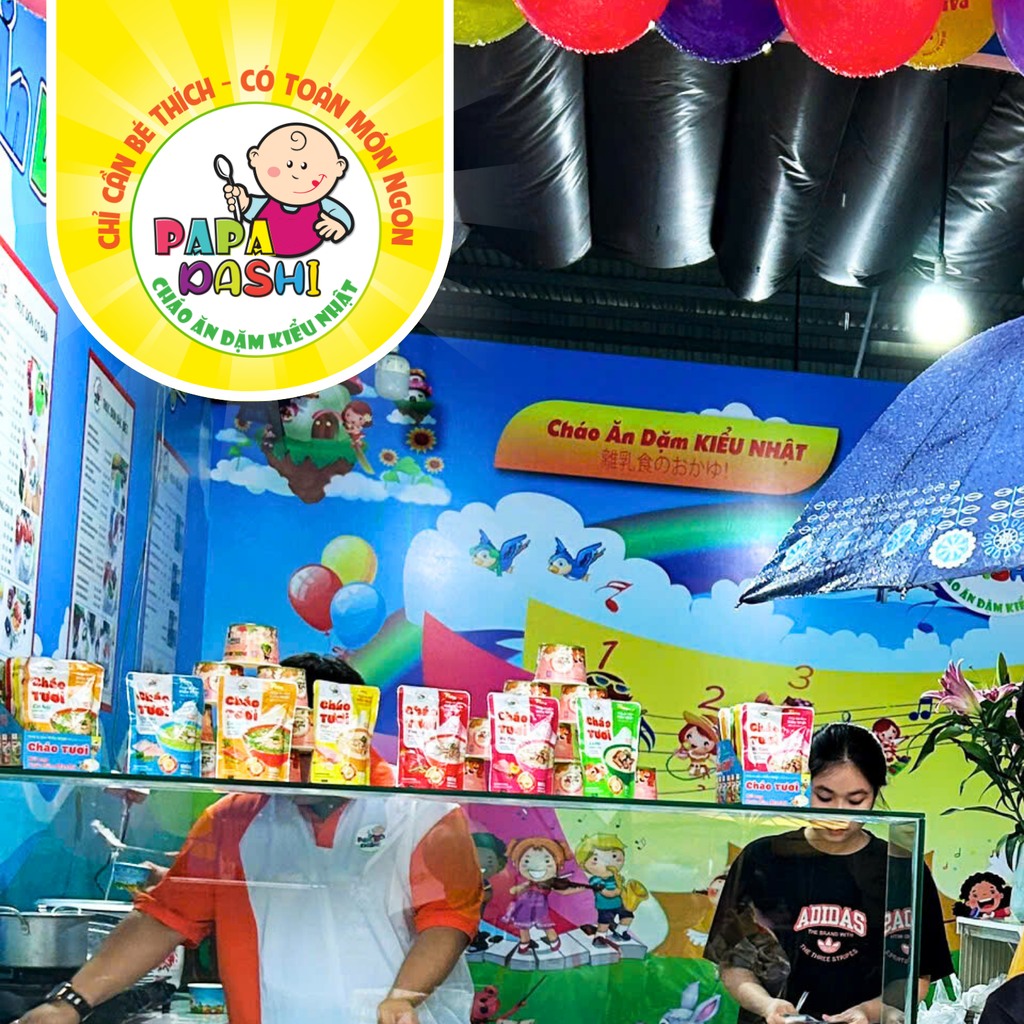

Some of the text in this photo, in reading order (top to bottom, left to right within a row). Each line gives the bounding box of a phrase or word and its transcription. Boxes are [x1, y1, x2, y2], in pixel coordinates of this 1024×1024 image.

[547, 418, 809, 466] Cháo Ăn Dặm KIỂU NHẬT
[601, 640, 619, 670] 1
[788, 665, 815, 690] 3
[698, 685, 725, 710] 2
[28, 742, 89, 755] Cháo Tươi
[746, 782, 799, 791] Cháo Tươi
[793, 903, 867, 937] ADIDAS
